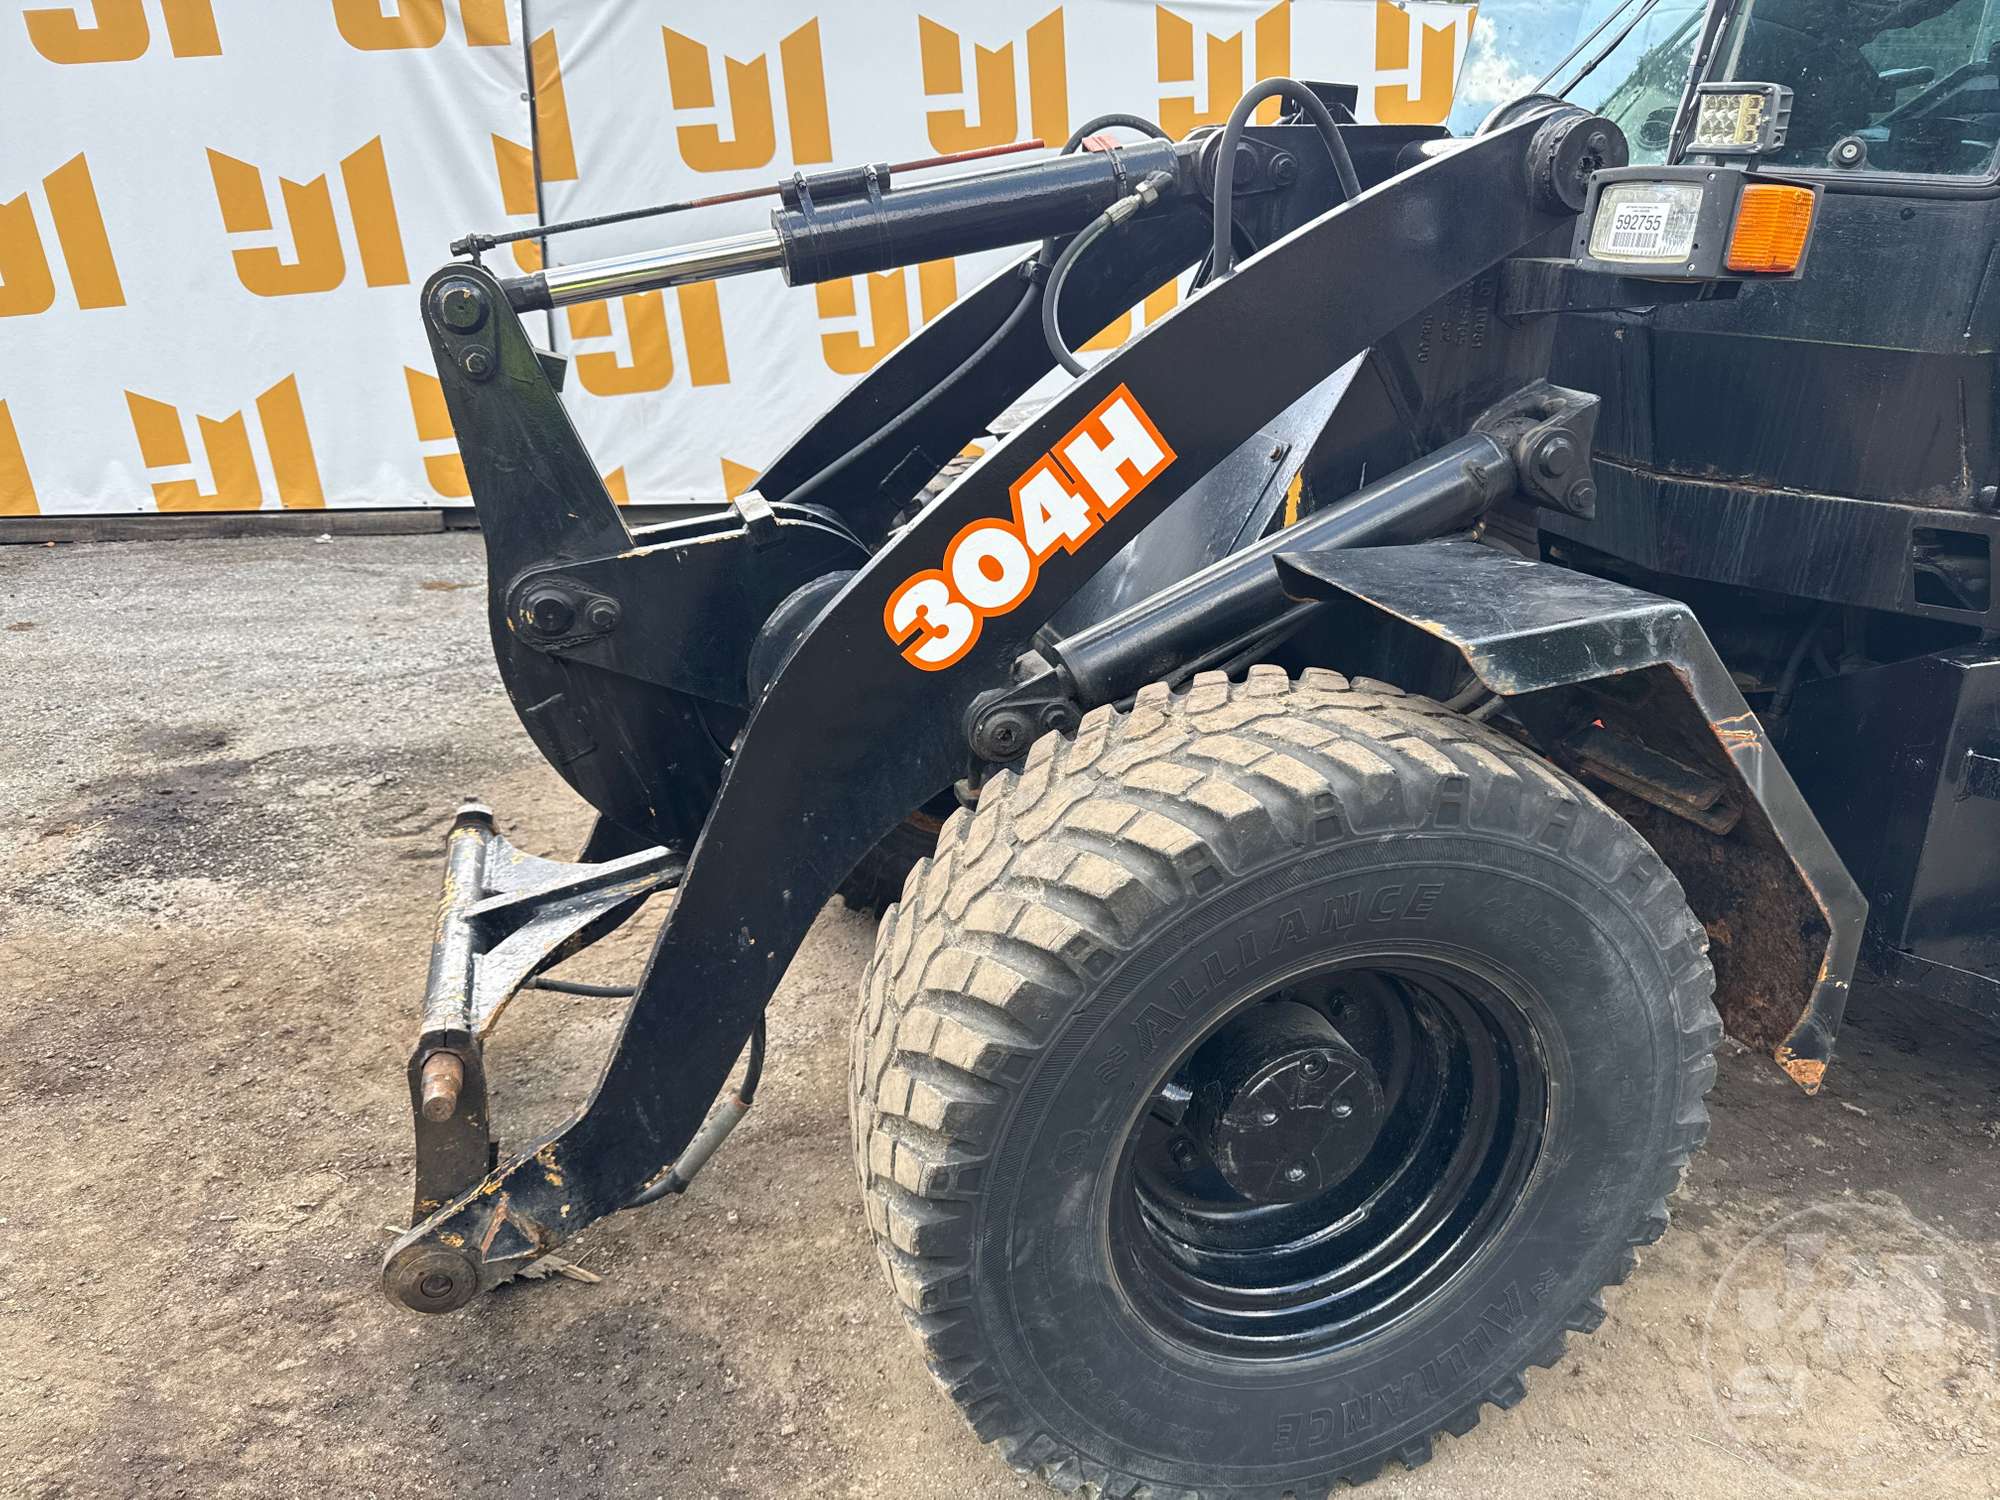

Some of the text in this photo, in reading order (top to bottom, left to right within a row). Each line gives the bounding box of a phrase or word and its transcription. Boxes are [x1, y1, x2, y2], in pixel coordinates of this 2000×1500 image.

[1615, 214, 1663, 231] 592755
[888, 390, 1177, 667] 304H
[1129, 881, 1446, 1059] ALLIANCE
[1270, 1279, 1529, 1456] ALLIANCE
